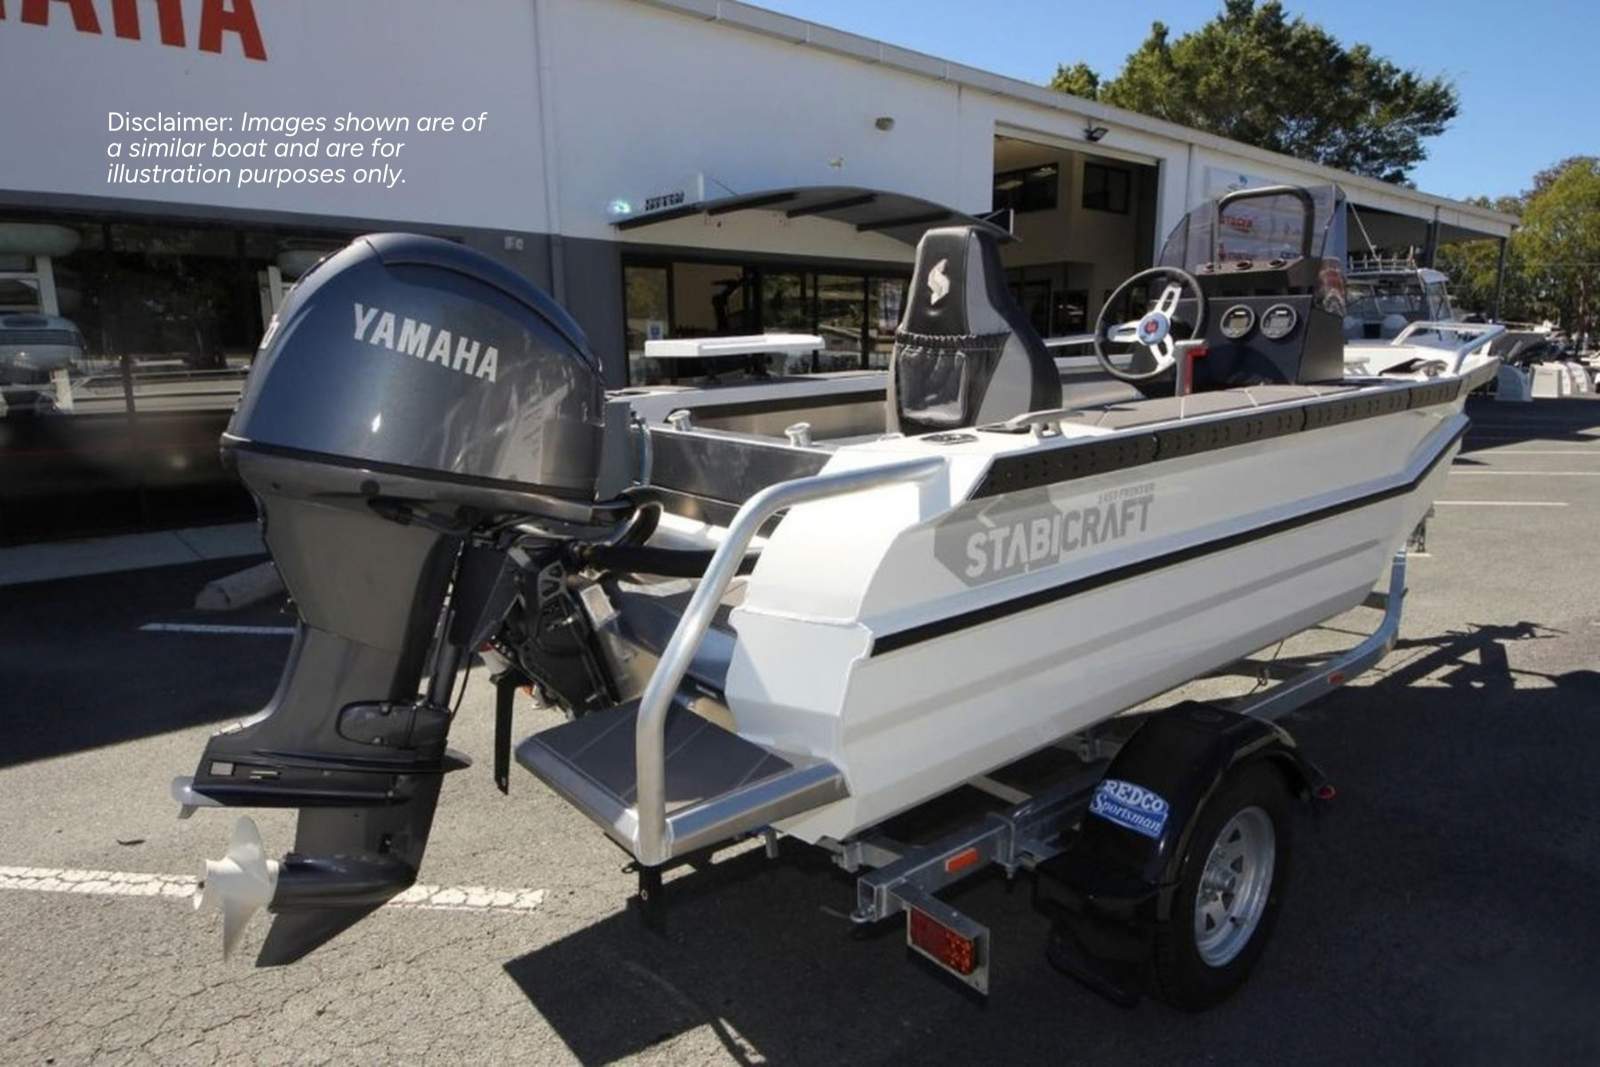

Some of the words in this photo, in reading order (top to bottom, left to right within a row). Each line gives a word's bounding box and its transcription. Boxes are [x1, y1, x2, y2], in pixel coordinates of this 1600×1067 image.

[354, 303, 499, 383] YAMAHA
[965, 495, 1154, 578] STABICRAFT
[1091, 793, 1162, 832] Sportsman
[1103, 780, 1164, 812] REDCO
